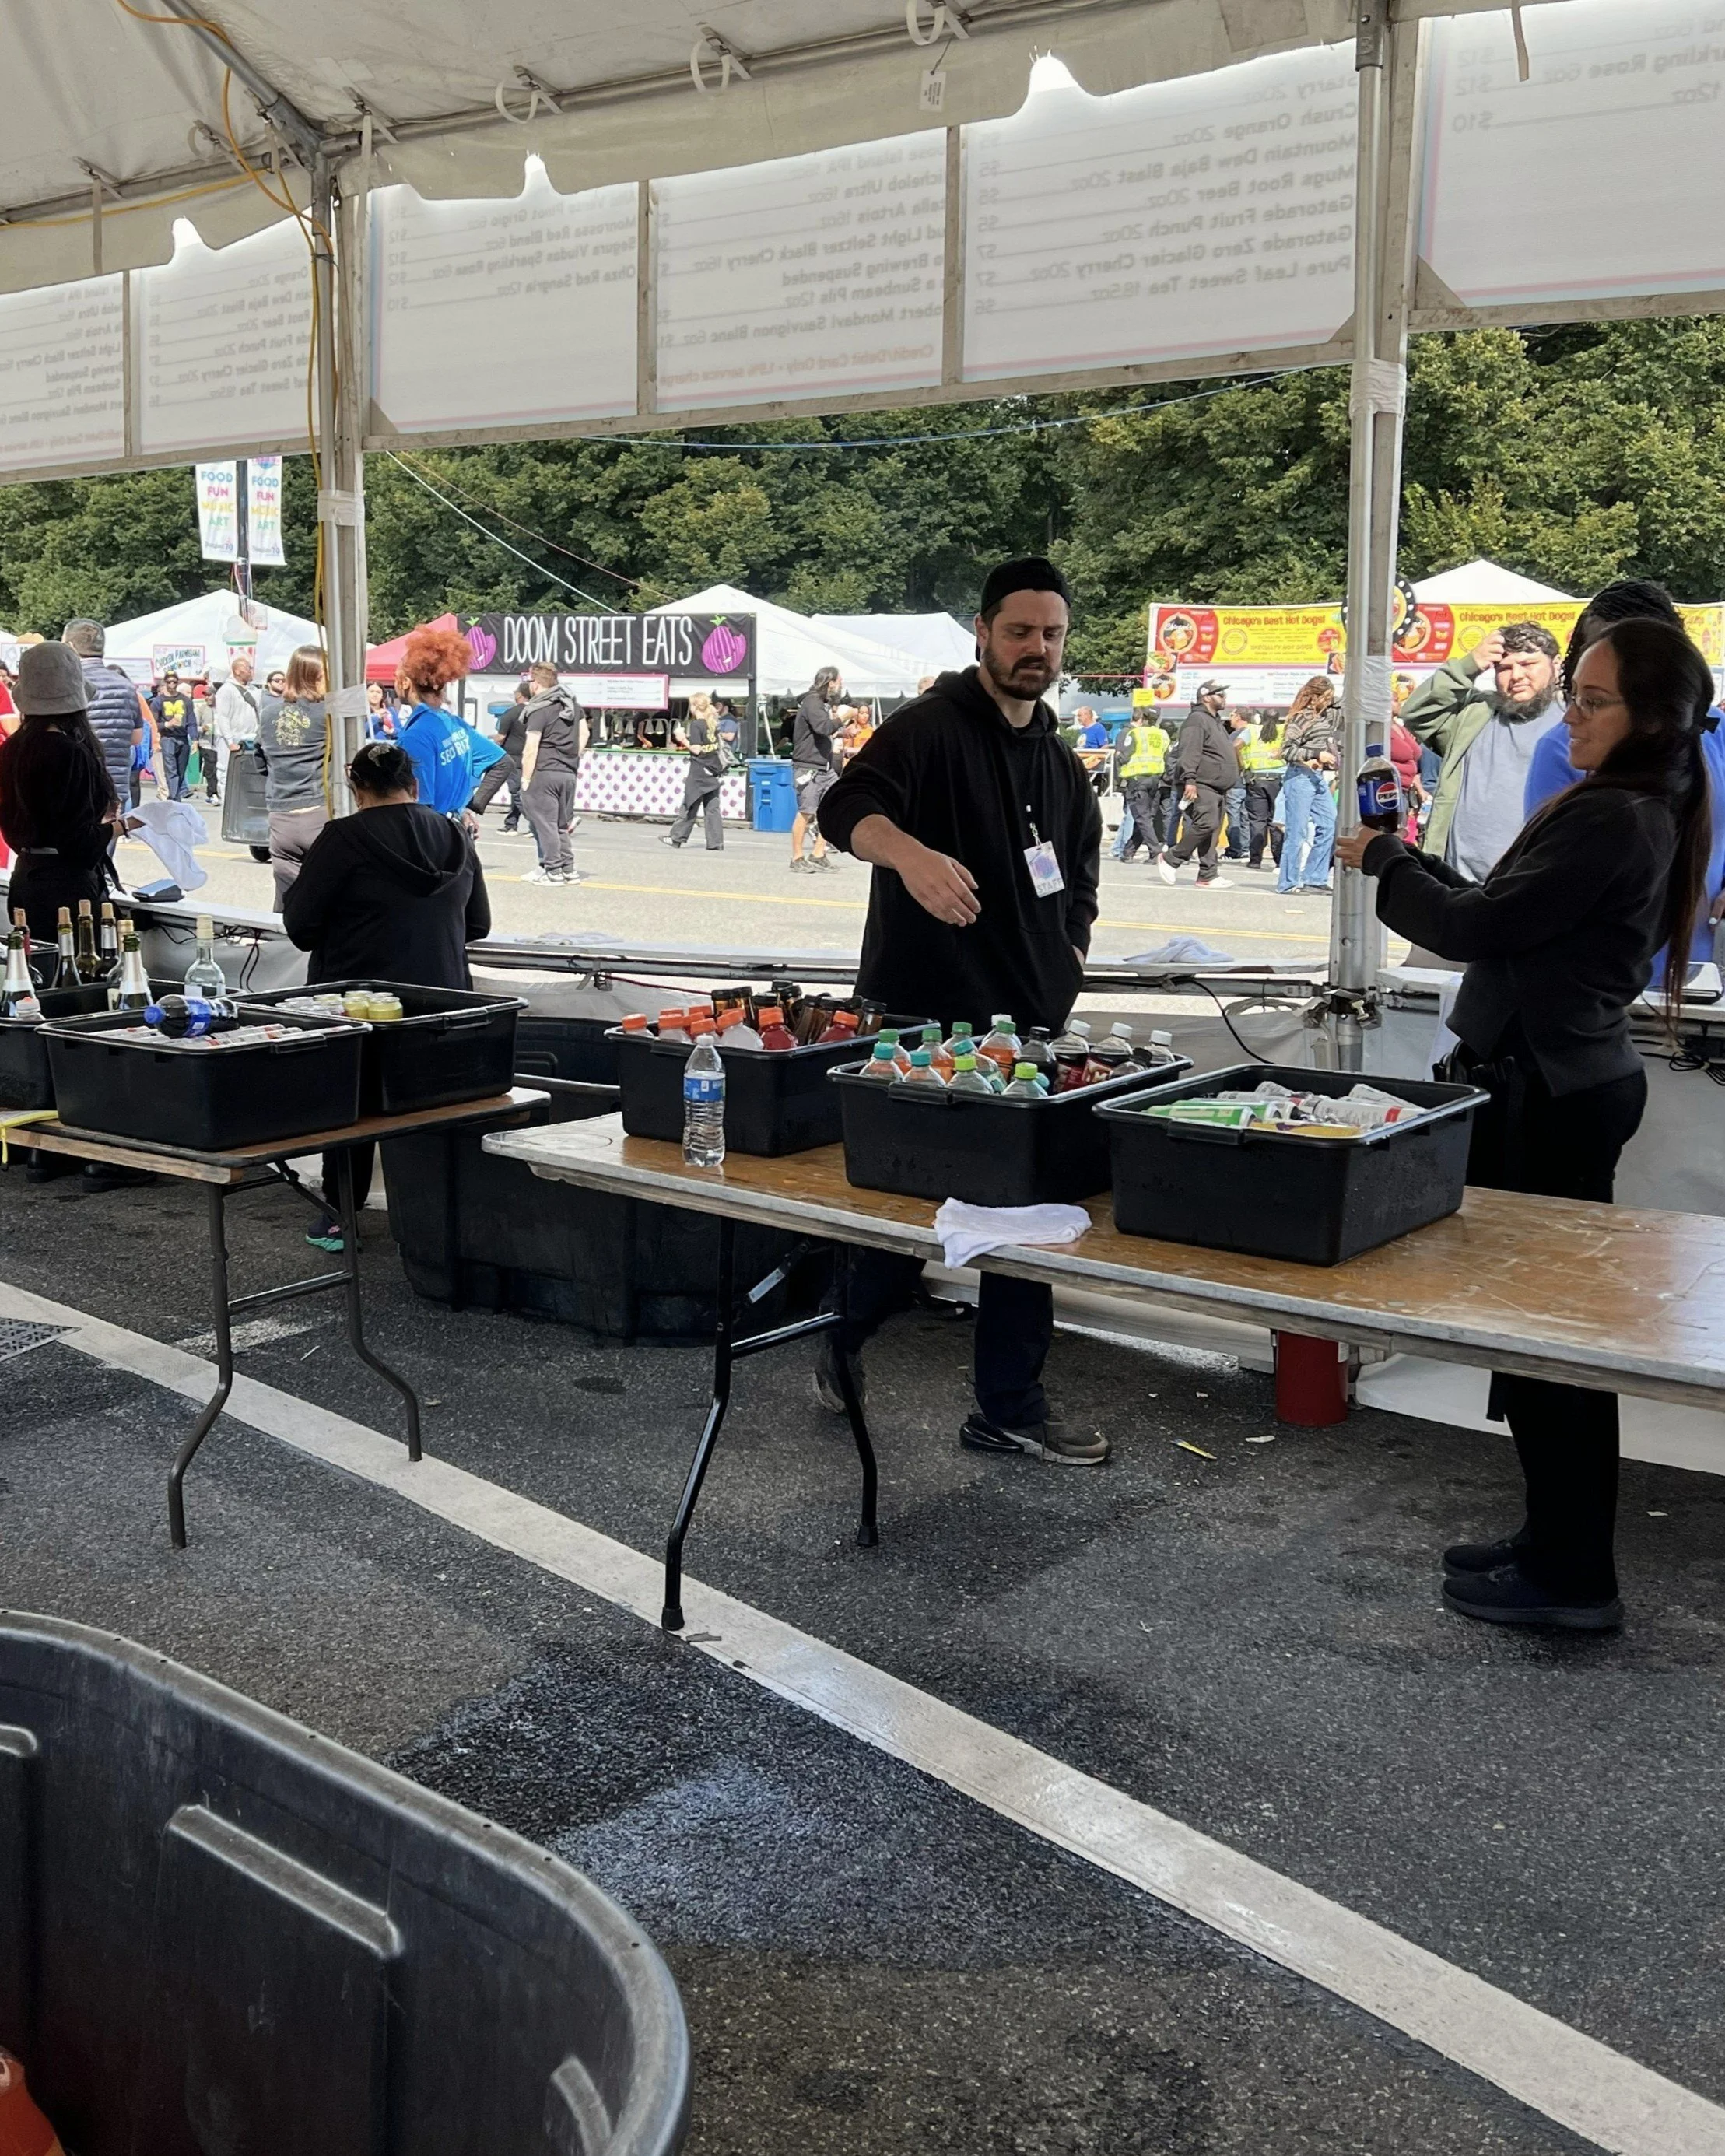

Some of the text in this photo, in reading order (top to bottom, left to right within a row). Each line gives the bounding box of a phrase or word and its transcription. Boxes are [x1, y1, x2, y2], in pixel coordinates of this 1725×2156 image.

[201, 471, 233, 482] FOOD
[251, 476, 279, 487] FOOD
[207, 486, 229, 497] FUN
[257, 491, 275, 502] FUN
[209, 516, 229, 527] ART
[257, 521, 275, 530] ART
[1223, 615, 1326, 627] Chicago's Best Hot Dogs!
[1459, 612, 1503, 622] Chicago's
[1506, 612, 1527, 621] Best
[1529, 612, 1547, 621] Hot
[1548, 612, 1576, 622] Dogs!
[504, 615, 692, 666] DOOM STREET EATS
[163, 700, 185, 716] M
[1037, 877, 1063, 894] STAFF
